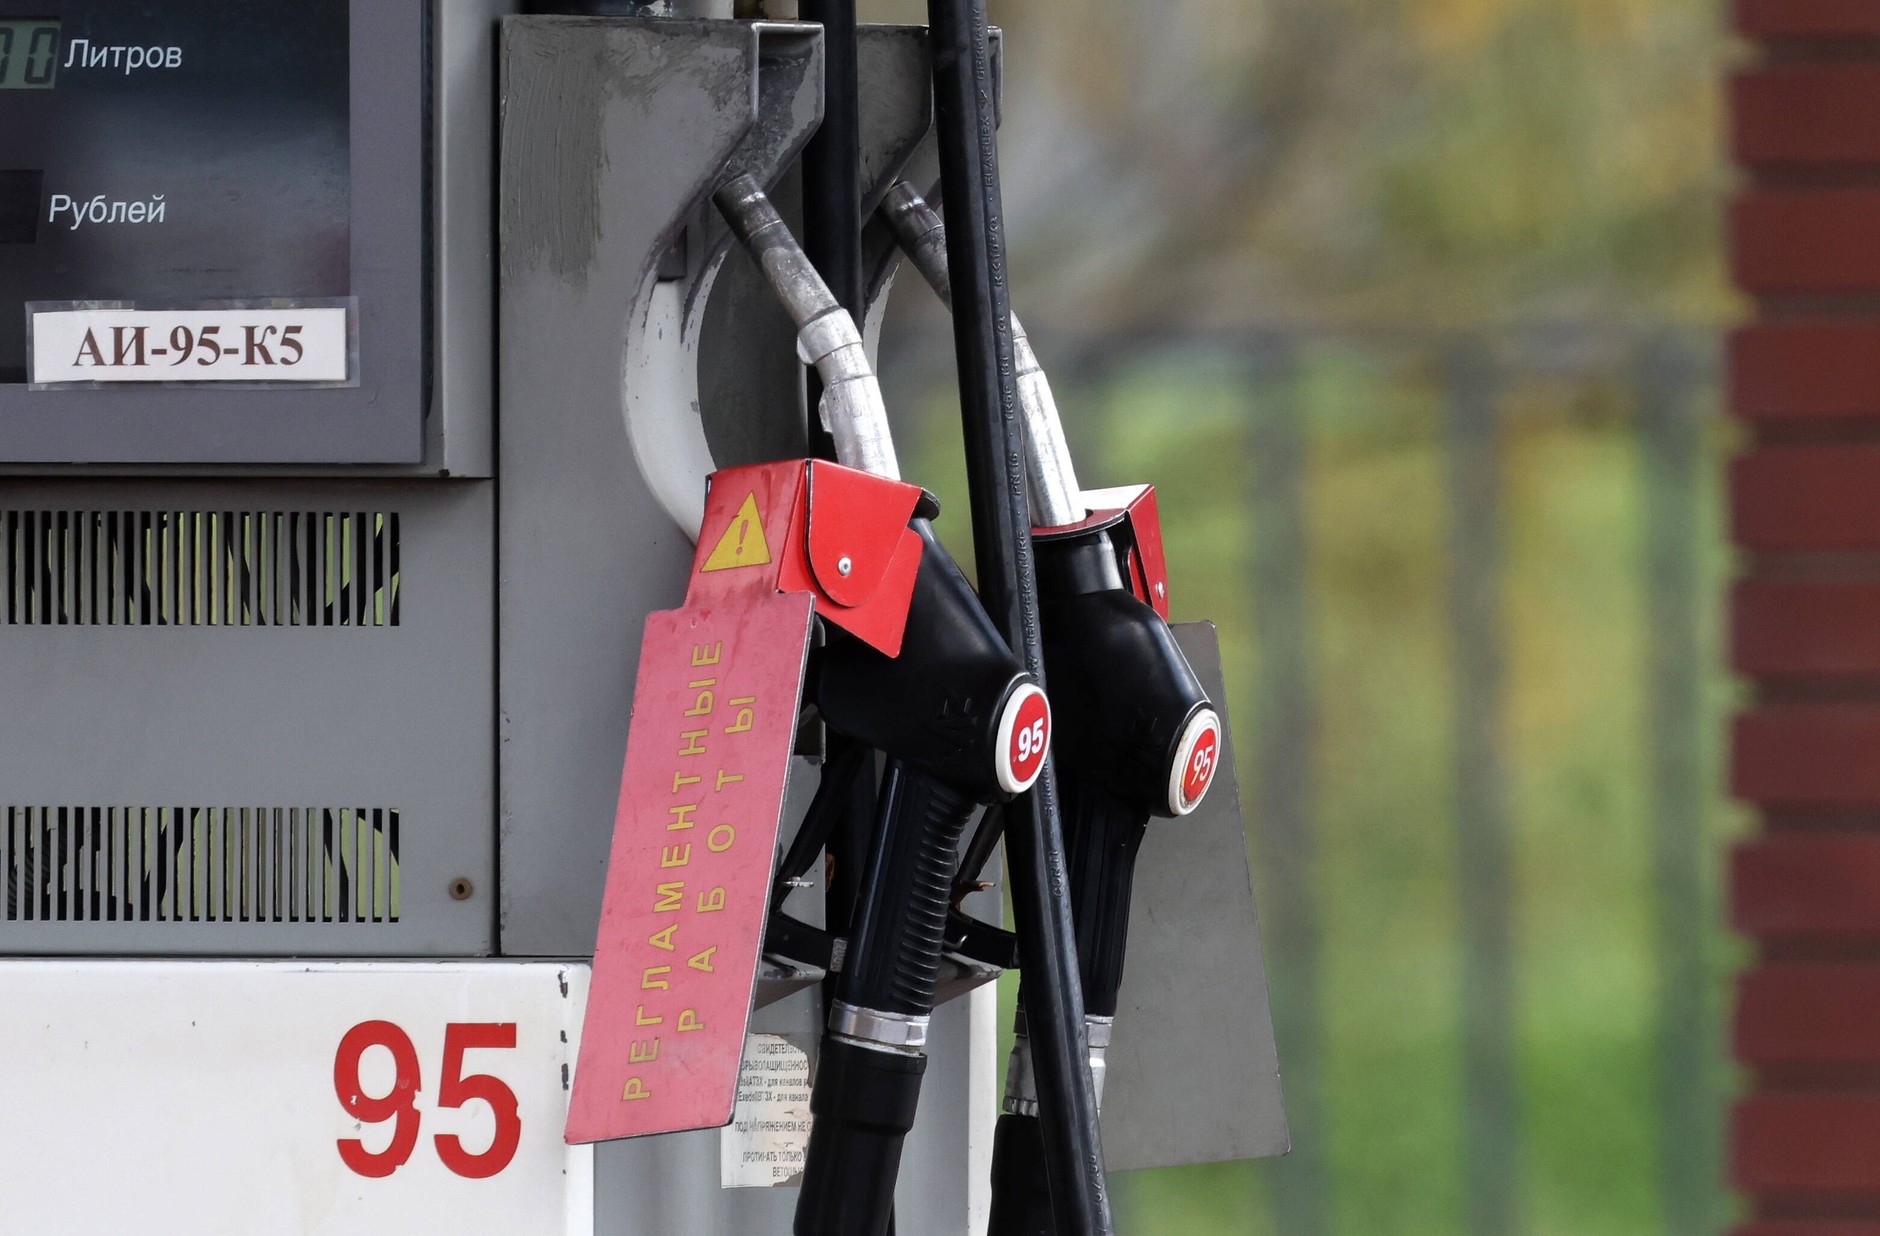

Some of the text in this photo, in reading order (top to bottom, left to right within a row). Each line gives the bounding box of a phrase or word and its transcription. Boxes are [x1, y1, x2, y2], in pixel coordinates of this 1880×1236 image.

[64, 39, 182, 75] Литров
[972, 8, 985, 80] GERMANY
[49, 194, 165, 230] Рублей
[72, 325, 304, 366] АИ-95-К5
[1018, 718, 1044, 762] 95
[1191, 745, 1214, 785] 95
[622, 641, 722, 1101] РЕГЛАМЕНТНЫЕ
[678, 696, 756, 1032] РАБОТЫ
[334, 1020, 521, 1178] 95
